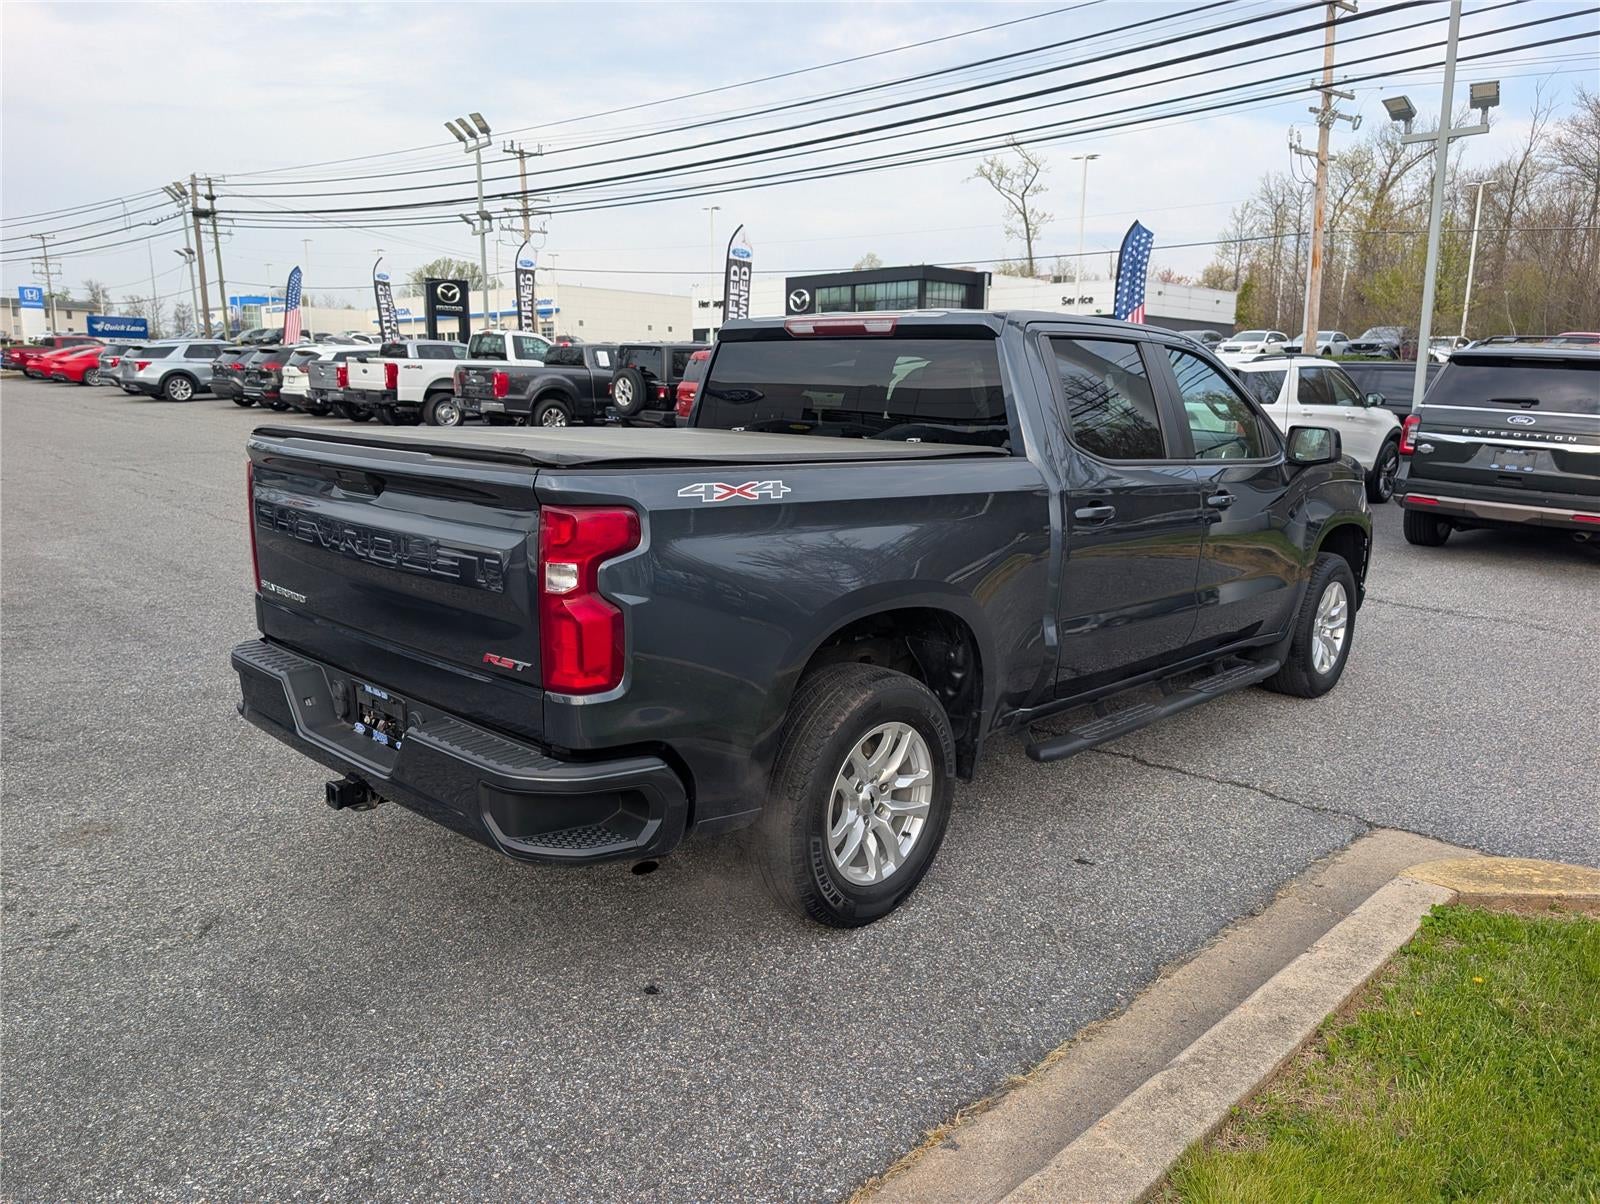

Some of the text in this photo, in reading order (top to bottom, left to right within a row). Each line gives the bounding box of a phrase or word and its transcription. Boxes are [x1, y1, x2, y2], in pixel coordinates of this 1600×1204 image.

[104, 323, 126, 331] Quick
[1462, 428, 1577, 442] EXPEDITION
[256, 503, 504, 593] CHEVROLET
[261, 579, 307, 604] SILVERADO
[483, 652, 532, 672] RST
[812, 840, 842, 906] MICHELIN
